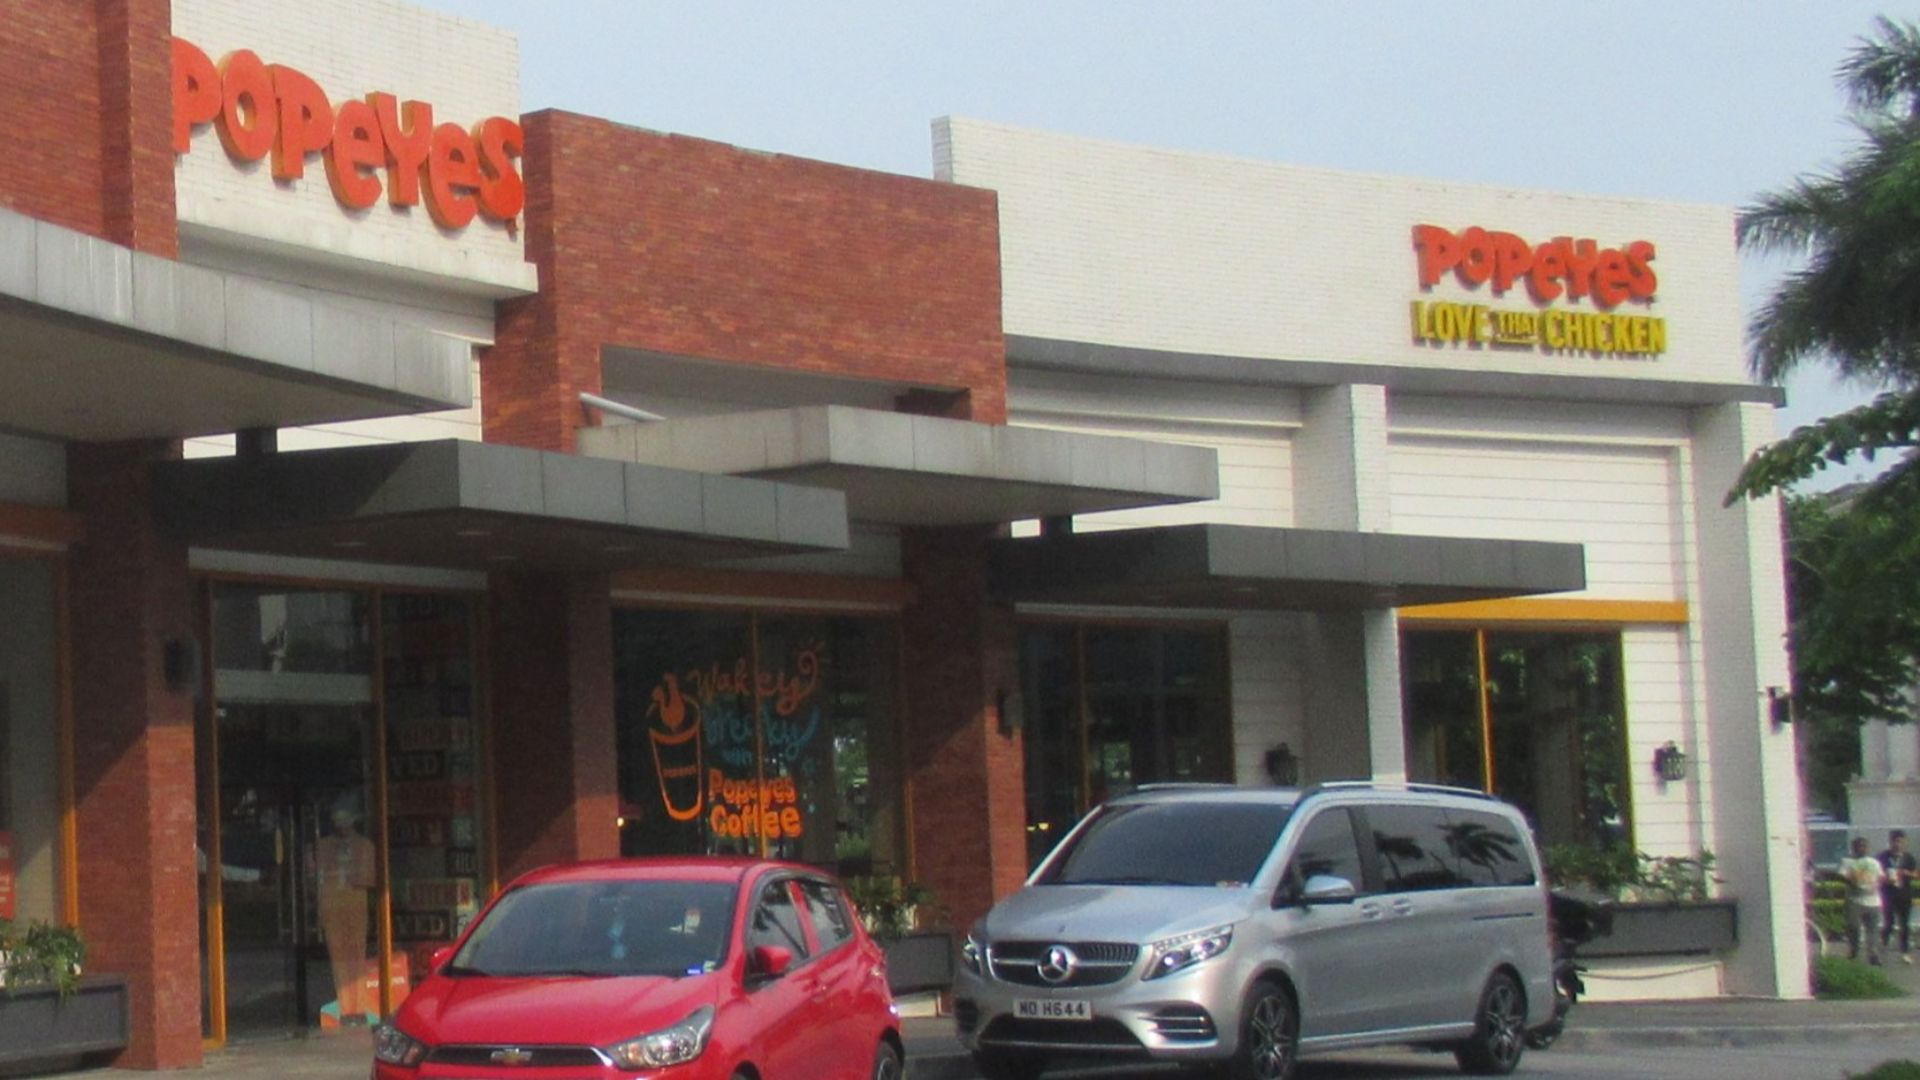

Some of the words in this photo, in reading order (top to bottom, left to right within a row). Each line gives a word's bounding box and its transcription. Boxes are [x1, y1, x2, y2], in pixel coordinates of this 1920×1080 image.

[1411, 224, 1658, 308] POPEYES
[1412, 301, 1490, 343] LOVE
[1497, 311, 1539, 335] THAT
[1545, 309, 1667, 354] CHICKEN
[709, 803, 802, 839] Coffee
